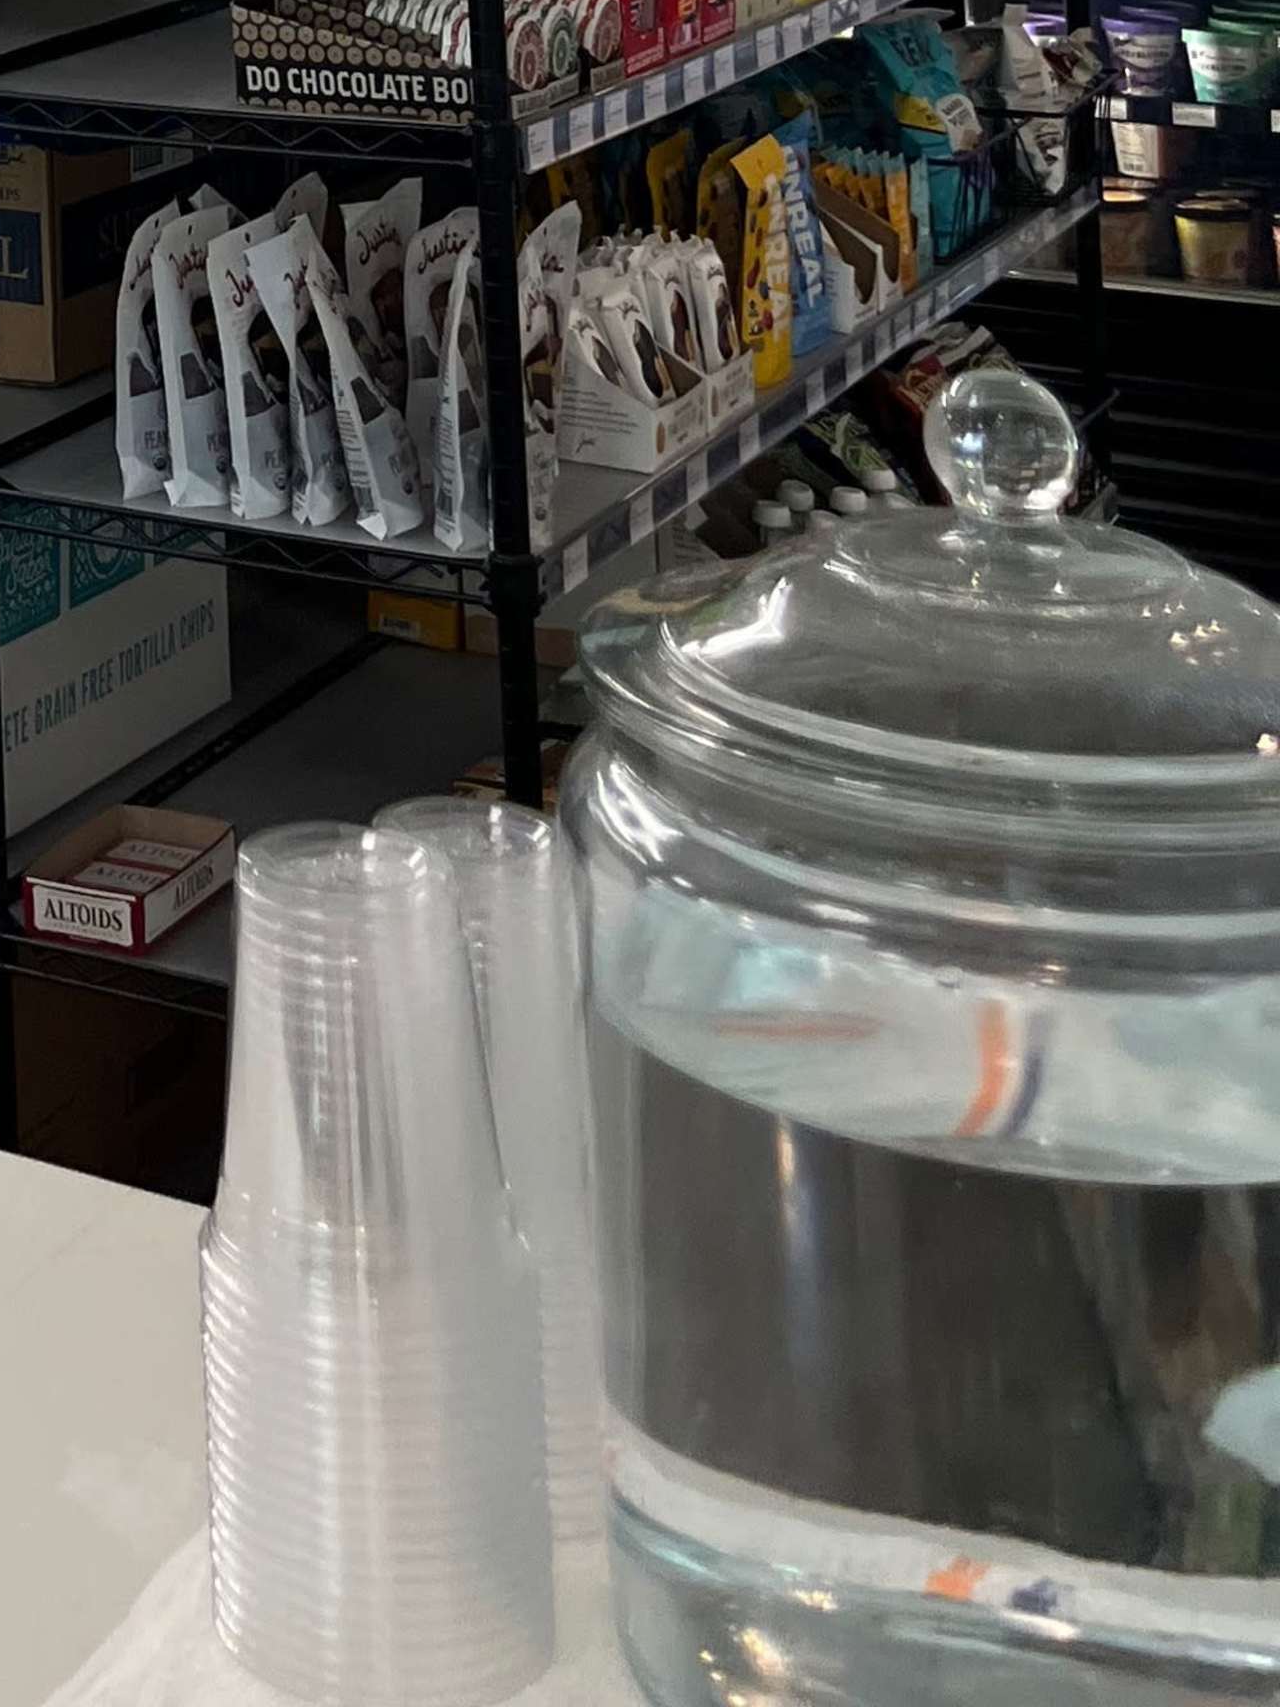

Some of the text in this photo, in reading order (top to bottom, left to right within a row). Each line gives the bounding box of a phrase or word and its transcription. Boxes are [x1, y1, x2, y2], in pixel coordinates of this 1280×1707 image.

[245, 64, 282, 93] DO
[287, 65, 428, 103] CHOCOLATE
[3, 599, 215, 754] ETE GRAIN FREE TORTILLA CHIPS
[42, 897, 123, 932] ALTOIDS
